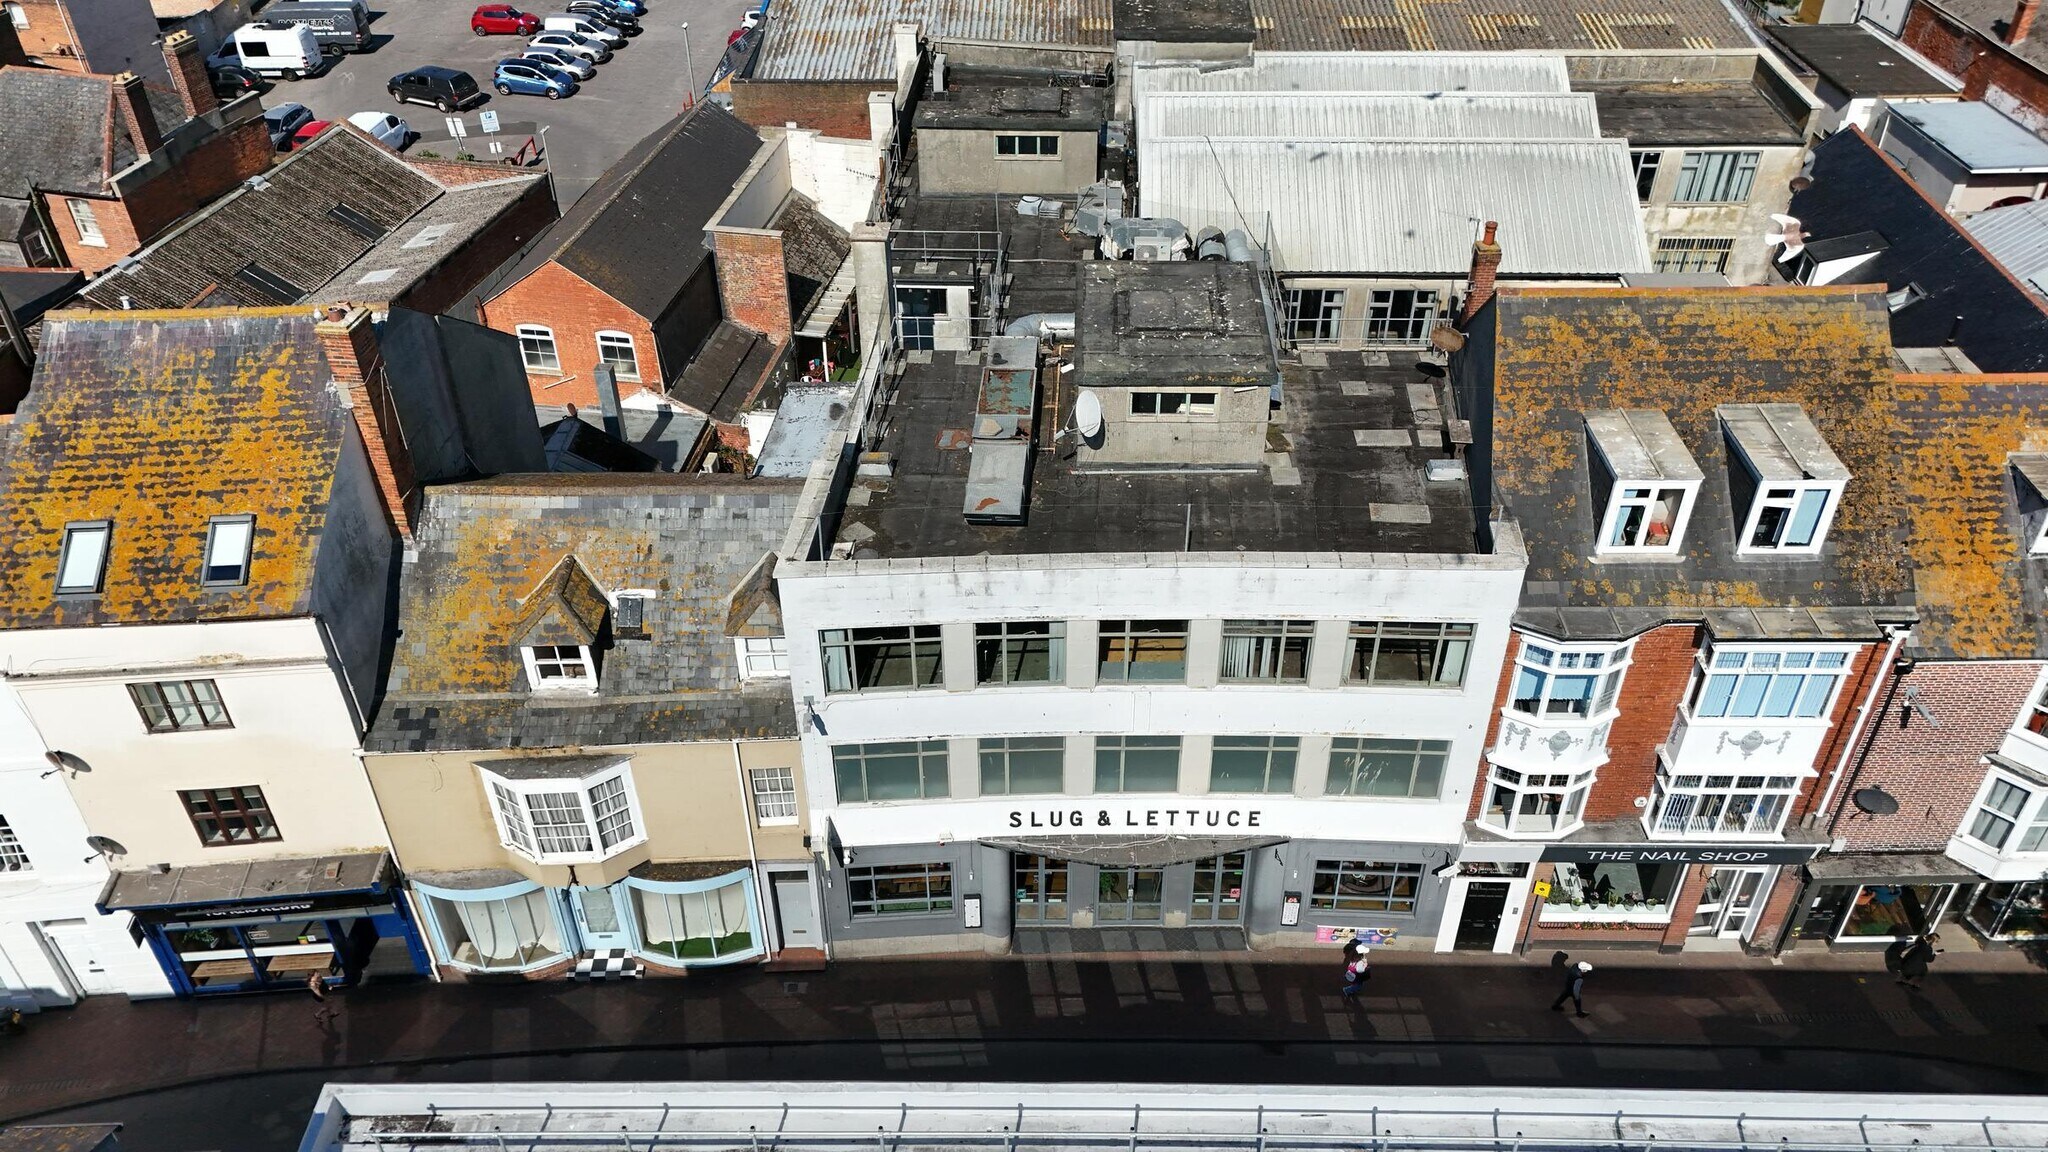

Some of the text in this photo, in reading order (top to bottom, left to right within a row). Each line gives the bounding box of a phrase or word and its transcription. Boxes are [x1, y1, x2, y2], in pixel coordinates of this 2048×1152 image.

[1009, 810, 1261, 828] SLUG & LETTUCE
[1587, 851, 1768, 862] THE NAIL SHOP
